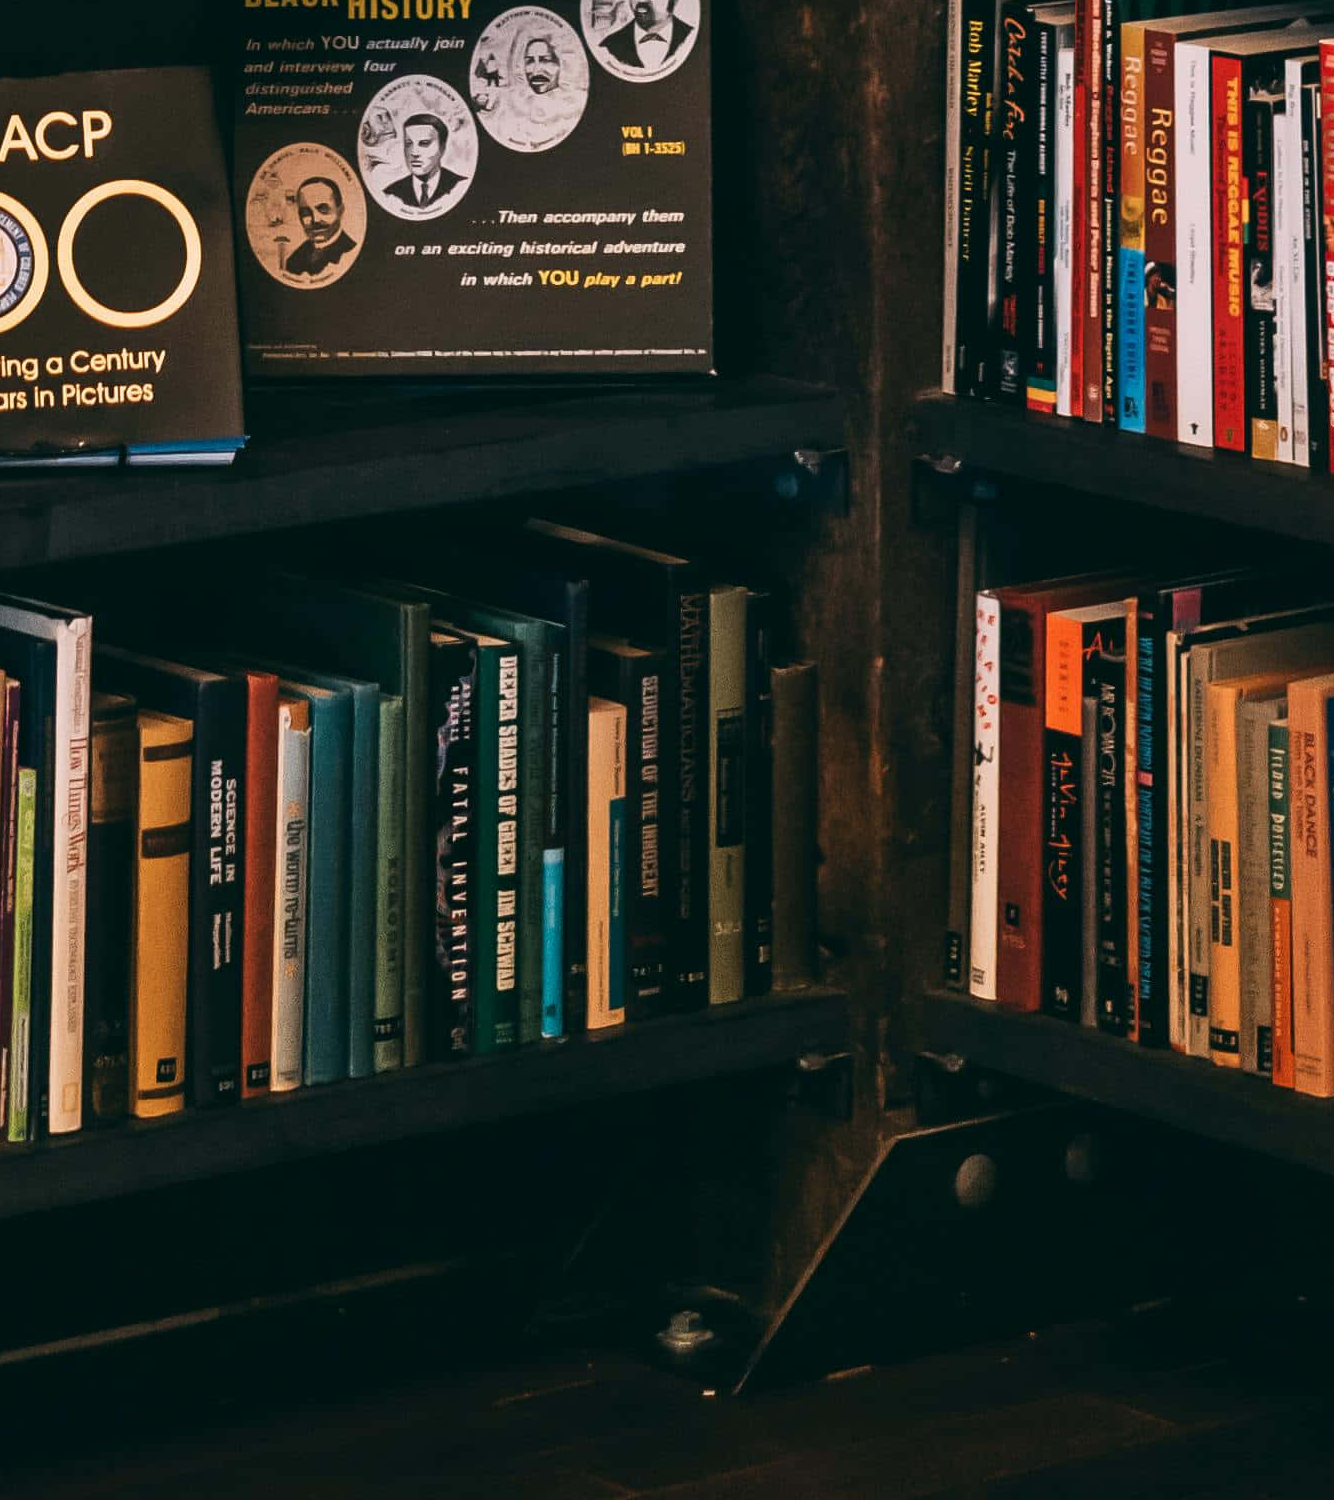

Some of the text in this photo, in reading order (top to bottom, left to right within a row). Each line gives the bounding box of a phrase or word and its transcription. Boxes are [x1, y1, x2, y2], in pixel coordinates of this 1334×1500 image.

[1147, 107, 1174, 226] Reggae
[544, 209, 637, 228] accompany
[642, 208, 684, 223] them
[47, 353, 65, 377] a
[70, 345, 167, 380] Century
[34, 384, 56, 408] in
[61, 380, 155, 409] Pictures
